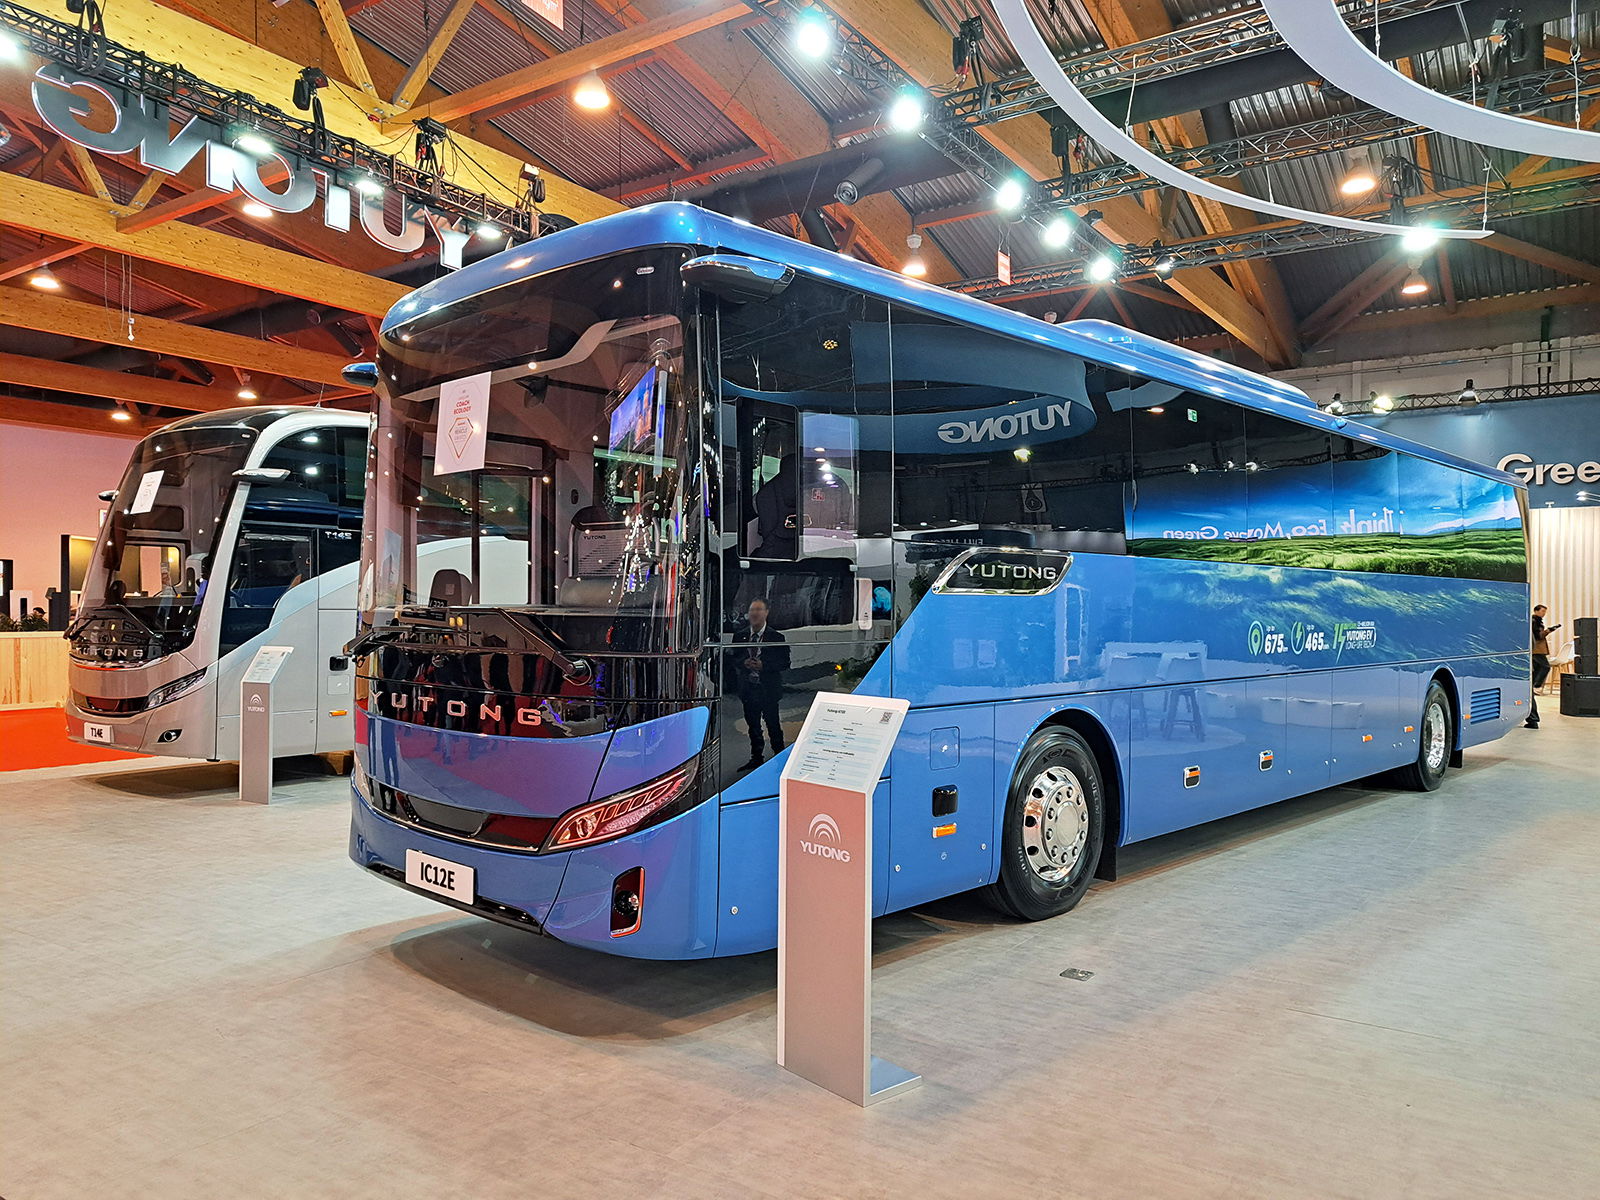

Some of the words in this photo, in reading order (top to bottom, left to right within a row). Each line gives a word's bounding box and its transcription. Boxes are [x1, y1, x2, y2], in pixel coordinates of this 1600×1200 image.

[963, 562, 1057, 580] YUTONG
[1264, 633, 1285, 654] 675
[1305, 632, 1325, 651] 465
[1346, 630, 1367, 641] YUTONG
[369, 690, 542, 726] YUTONG
[90, 727, 104, 739] T14E
[800, 840, 851, 862] YUTONG
[420, 862, 456, 891] IC12E
